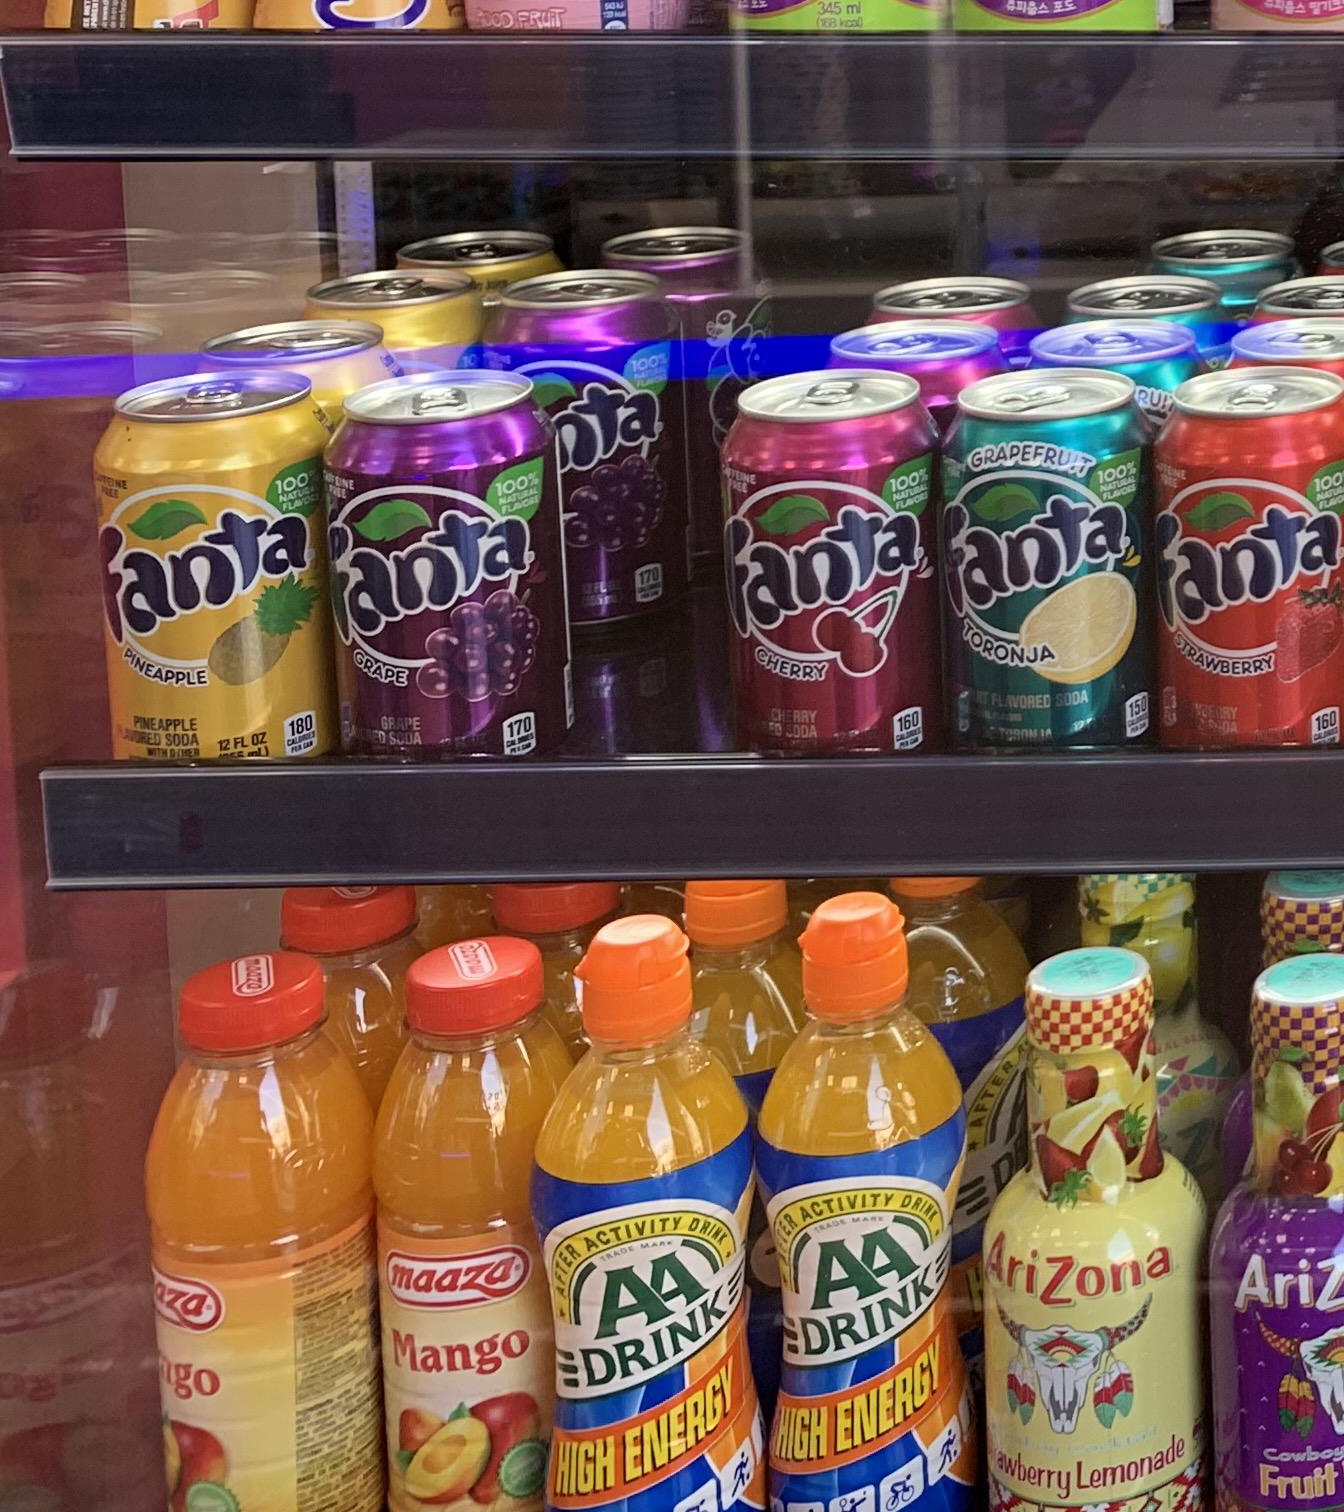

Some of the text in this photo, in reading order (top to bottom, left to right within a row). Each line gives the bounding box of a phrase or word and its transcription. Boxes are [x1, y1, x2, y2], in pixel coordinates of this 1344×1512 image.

[817, 1, 842, 16] 345
[552, 381, 662, 473] nta
[888, 460, 930, 490] 100%
[969, 442, 1096, 476] GRAPEFRUIT
[1096, 460, 1137, 486] 100%
[495, 472, 540, 493] 100%
[754, 645, 828, 681] CHERRY
[961, 626, 1057, 666] TORONJA
[1174, 632, 1277, 678] STRAWBERRY
[122, 646, 209, 687] PINEAPPLE
[353, 648, 410, 687] GRAPE
[133, 715, 199, 732] PINEAPPLE
[288, 712, 314, 734] 180
[506, 714, 533, 736] 170
[896, 710, 919, 731] 160
[1128, 696, 1148, 717] 150
[1315, 710, 1337, 730] 160
[165, 731, 200, 746] SODA
[799, 1191, 939, 1223] ACTIVITY DRINK
[583, 1215, 729, 1255] ACTIVITY DRINK
[390, 1251, 518, 1298] maaza
[810, 1226, 921, 1311] AA
[984, 1231, 1175, 1308] AriZona
[593, 1251, 709, 1341] AA
[799, 1269, 936, 1357] DRINK
[392, 1327, 531, 1376] Mango
[579, 1281, 728, 1388] DRINK
[774, 1402, 828, 1460] HIGH
[835, 1335, 942, 1453] ENERGY
[553, 1355, 736, 1498] HIGH ENERGY
[1075, 1433, 1186, 1491] Lemonade
[1259, 1458, 1336, 1501] Fruit
